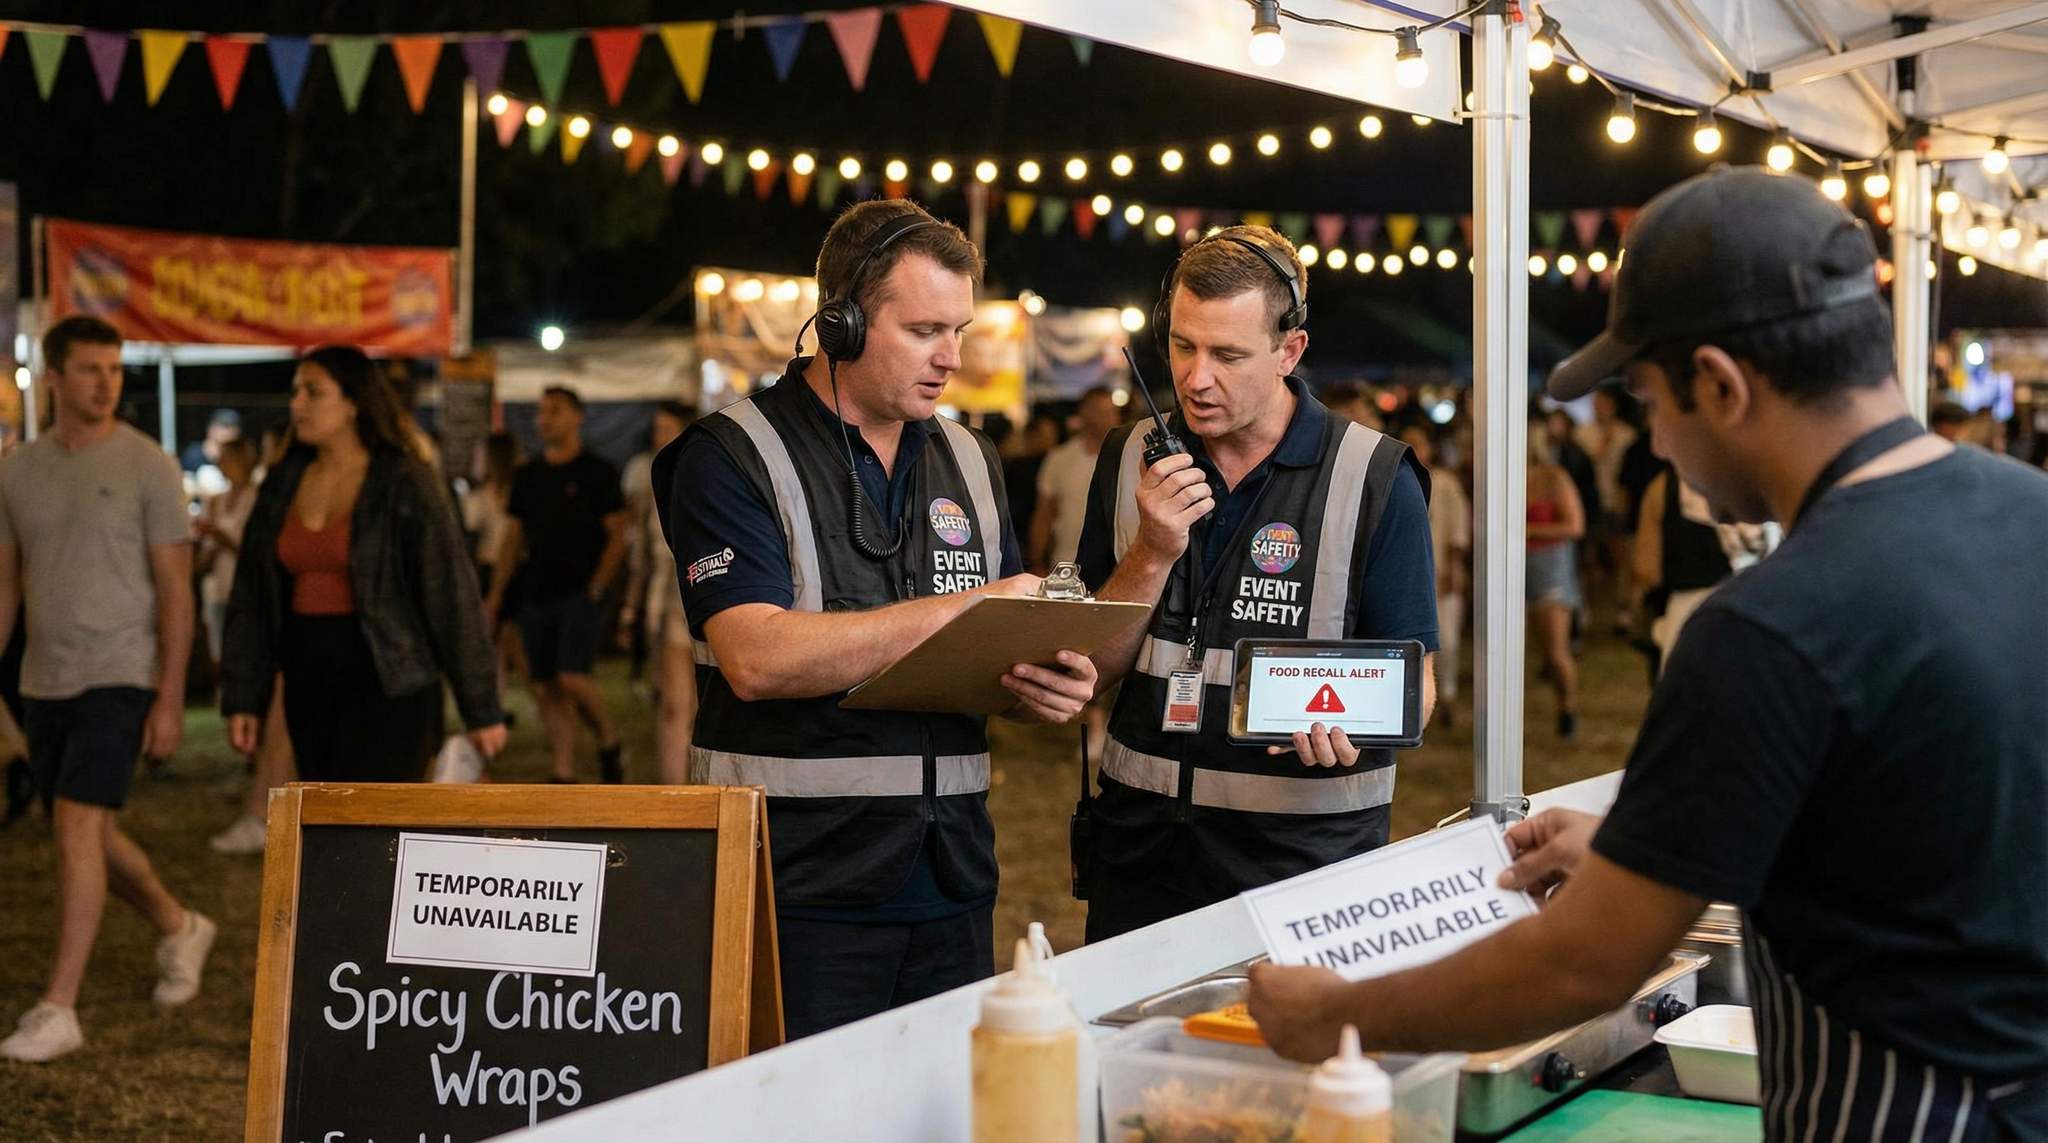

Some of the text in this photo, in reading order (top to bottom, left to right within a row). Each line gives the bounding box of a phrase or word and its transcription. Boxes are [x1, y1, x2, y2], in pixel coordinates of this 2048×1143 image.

[933, 550, 982, 572] EVENT
[1240, 576, 1302, 602] EVENT
[1231, 599, 1304, 627] SAFETY
[1269, 667, 1387, 679] FOOD RECALL ALERT
[415, 871, 584, 902] TEMPORARILY
[413, 904, 579, 935] UNAVAILABLE
[1286, 866, 1488, 942] TEMPORARILY
[323, 960, 684, 1055] Spicy Chicken
[429, 1049, 583, 1129] Wraps
